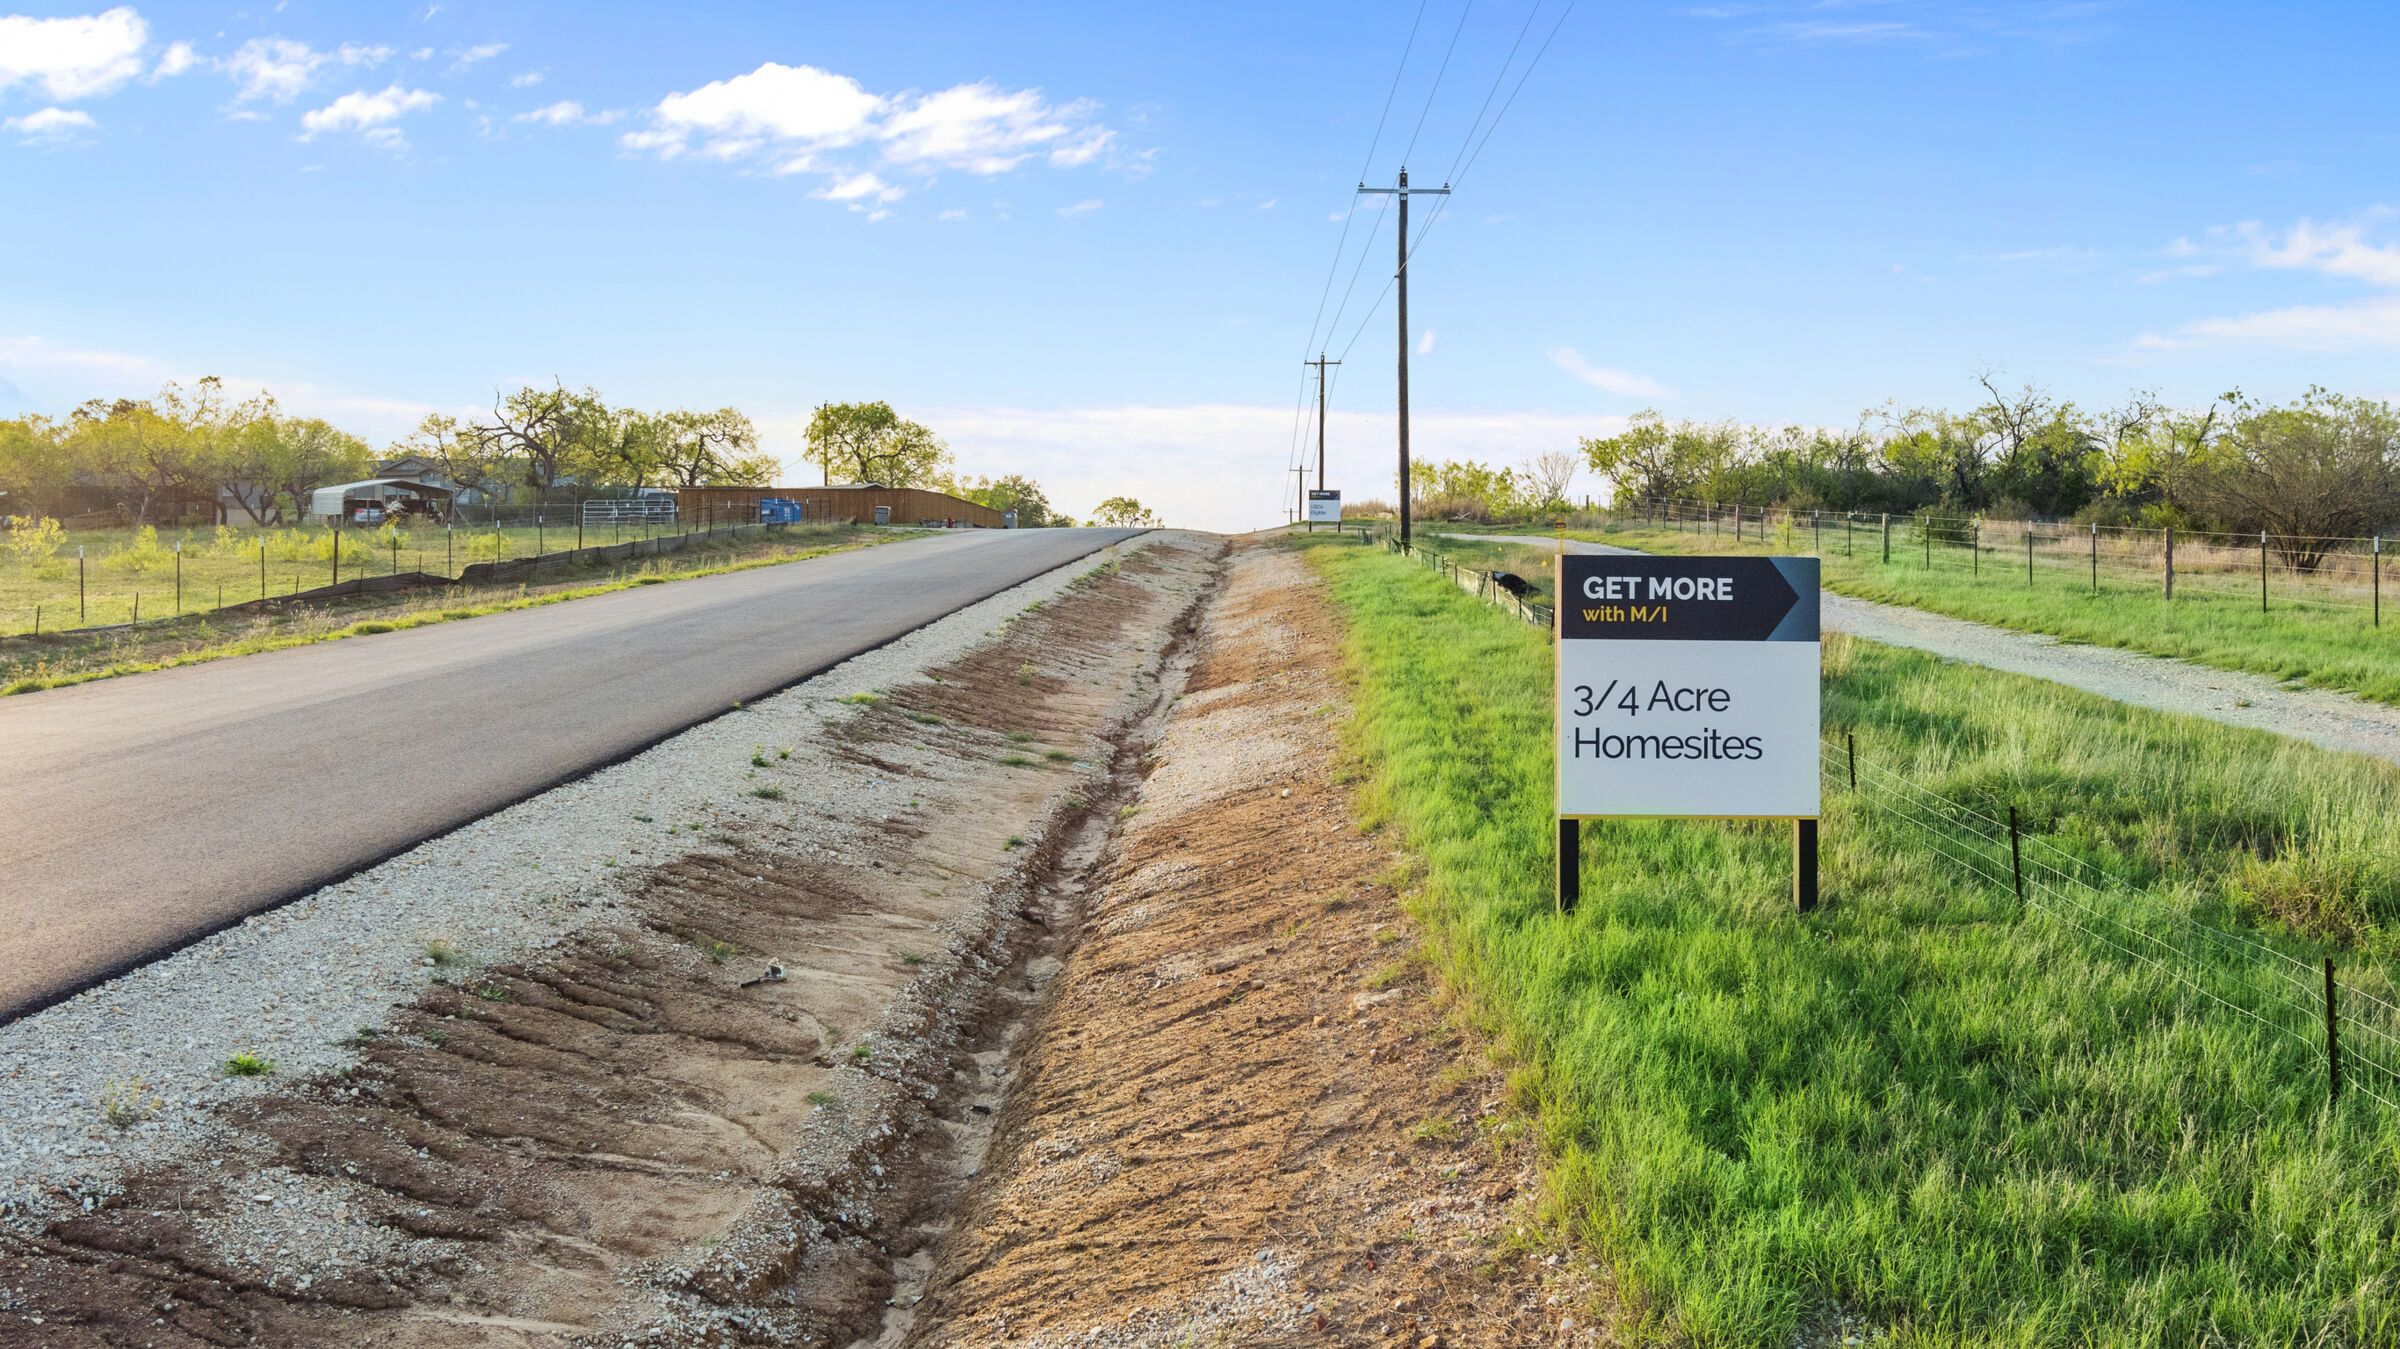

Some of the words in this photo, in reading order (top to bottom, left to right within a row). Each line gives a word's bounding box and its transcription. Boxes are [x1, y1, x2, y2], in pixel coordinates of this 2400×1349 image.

[1582, 576, 1641, 600] GET
[1649, 577, 1733, 601] MORE
[1582, 605, 1625, 622] with
[1631, 606, 1667, 623] M/I
[1573, 679, 1639, 717] 3/4
[1647, 680, 1731, 712] Acre
[1574, 727, 1763, 760] Homesites
